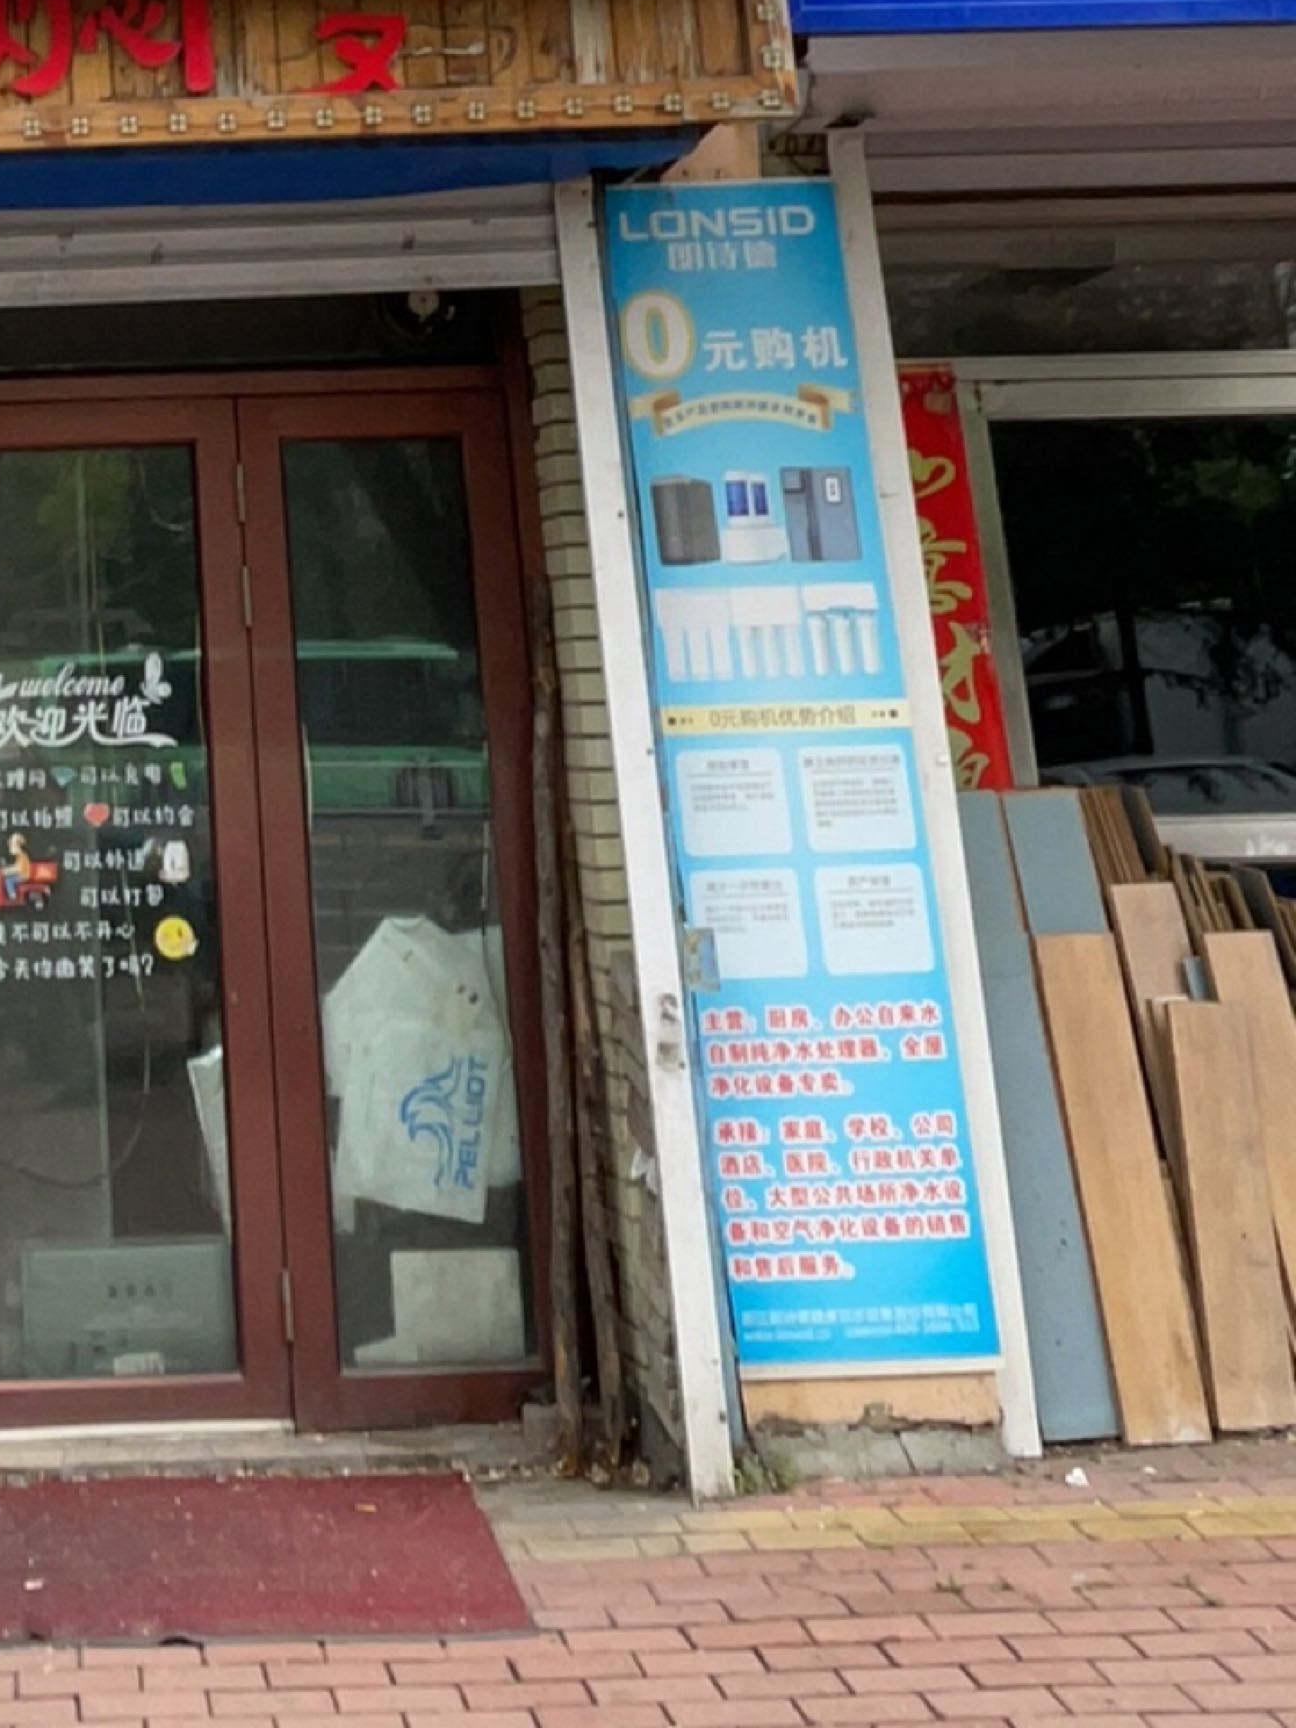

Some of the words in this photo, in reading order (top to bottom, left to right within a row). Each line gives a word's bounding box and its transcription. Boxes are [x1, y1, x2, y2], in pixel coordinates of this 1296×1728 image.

[618, 205, 816, 242] LONSID
[621, 290, 849, 379] 0元购机
[19, 661, 125, 697] welcome
[112, 803, 195, 828] 可以约会
